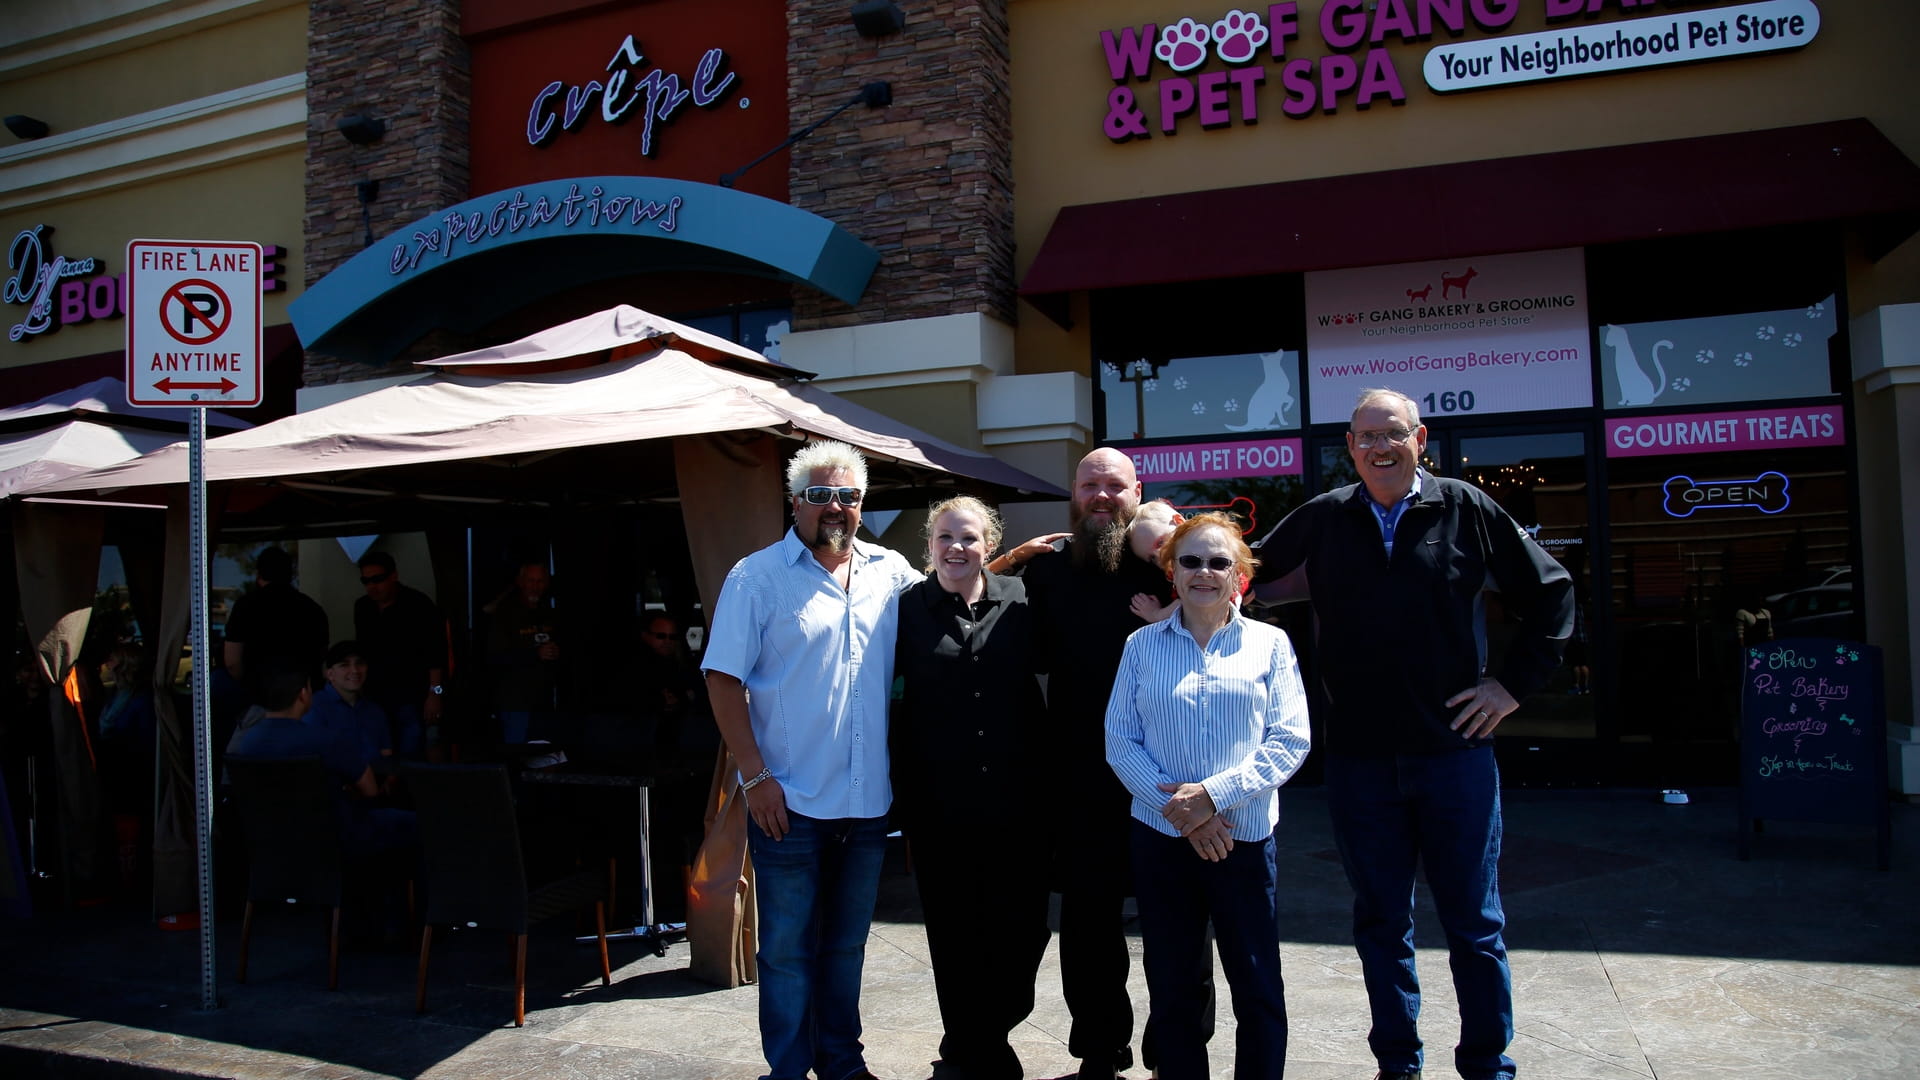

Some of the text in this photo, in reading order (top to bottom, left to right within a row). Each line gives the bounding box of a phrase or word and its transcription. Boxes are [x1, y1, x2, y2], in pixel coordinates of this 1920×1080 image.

[1440, 13, 1804, 80] Your Neighborhood Pet Store
[1103, 47, 1406, 140] & PET SPA
[389, 184, 682, 275] expectations
[142, 252, 187, 271] FIRE
[196, 252, 249, 272] LANE
[1370, 308, 1414, 322] GANG
[1418, 303, 1471, 319] BAKERY
[1477, 302, 1485, 314] &
[1488, 295, 1575, 313] GROOMING
[1361, 326, 1386, 337] Your
[1390, 319, 1475, 335] Neighborhood
[1479, 317, 1498, 328] Pet
[151, 353, 241, 371] ANYTIME
[1320, 347, 1578, 378] www.WoofGangBakery.com
[1423, 390, 1475, 413] 160
[1613, 413, 1834, 449] GOURMET TREATS
[1134, 445, 1294, 475] EMIUM PET FOOD
[1683, 486, 1767, 502] OPEN
[1545, 537, 1583, 545] GROOMING
